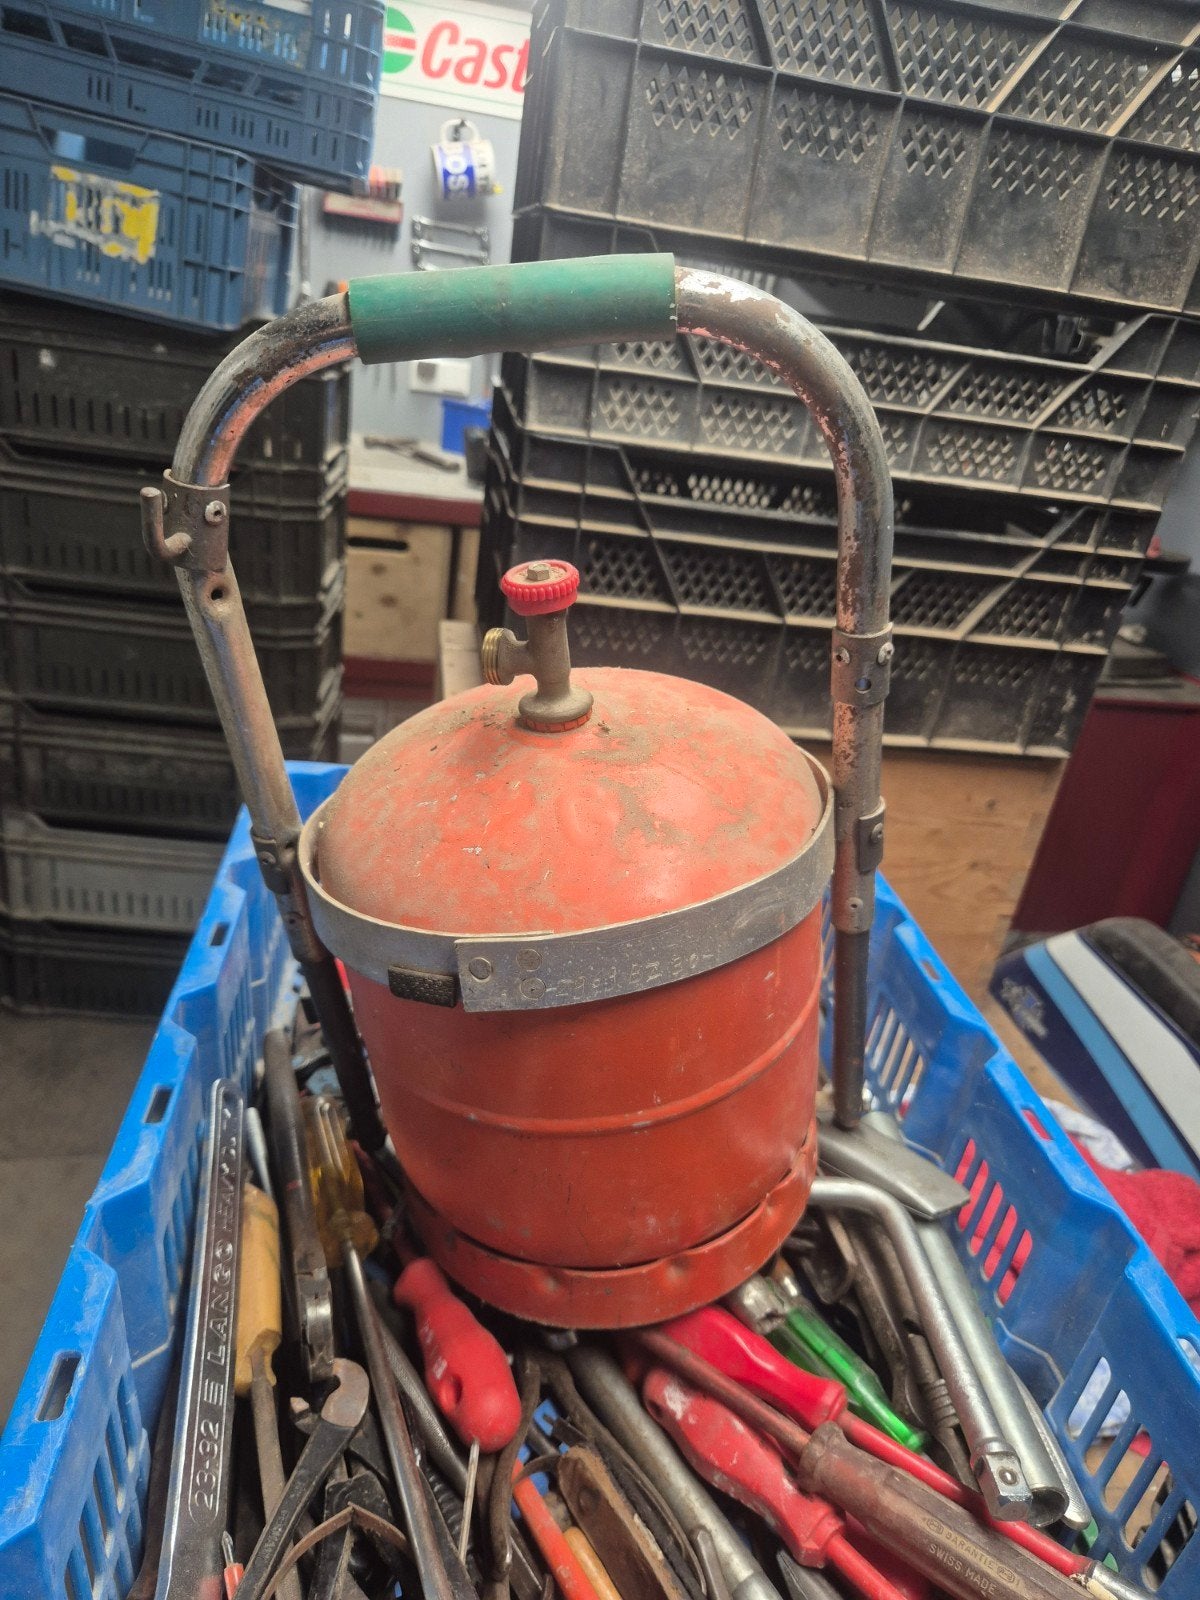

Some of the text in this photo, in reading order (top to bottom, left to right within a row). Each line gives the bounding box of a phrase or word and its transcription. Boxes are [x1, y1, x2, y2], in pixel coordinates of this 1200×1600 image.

[195, 1418, 220, 1511] 23-32
[929, 1543, 997, 1595] SWISS MADE
